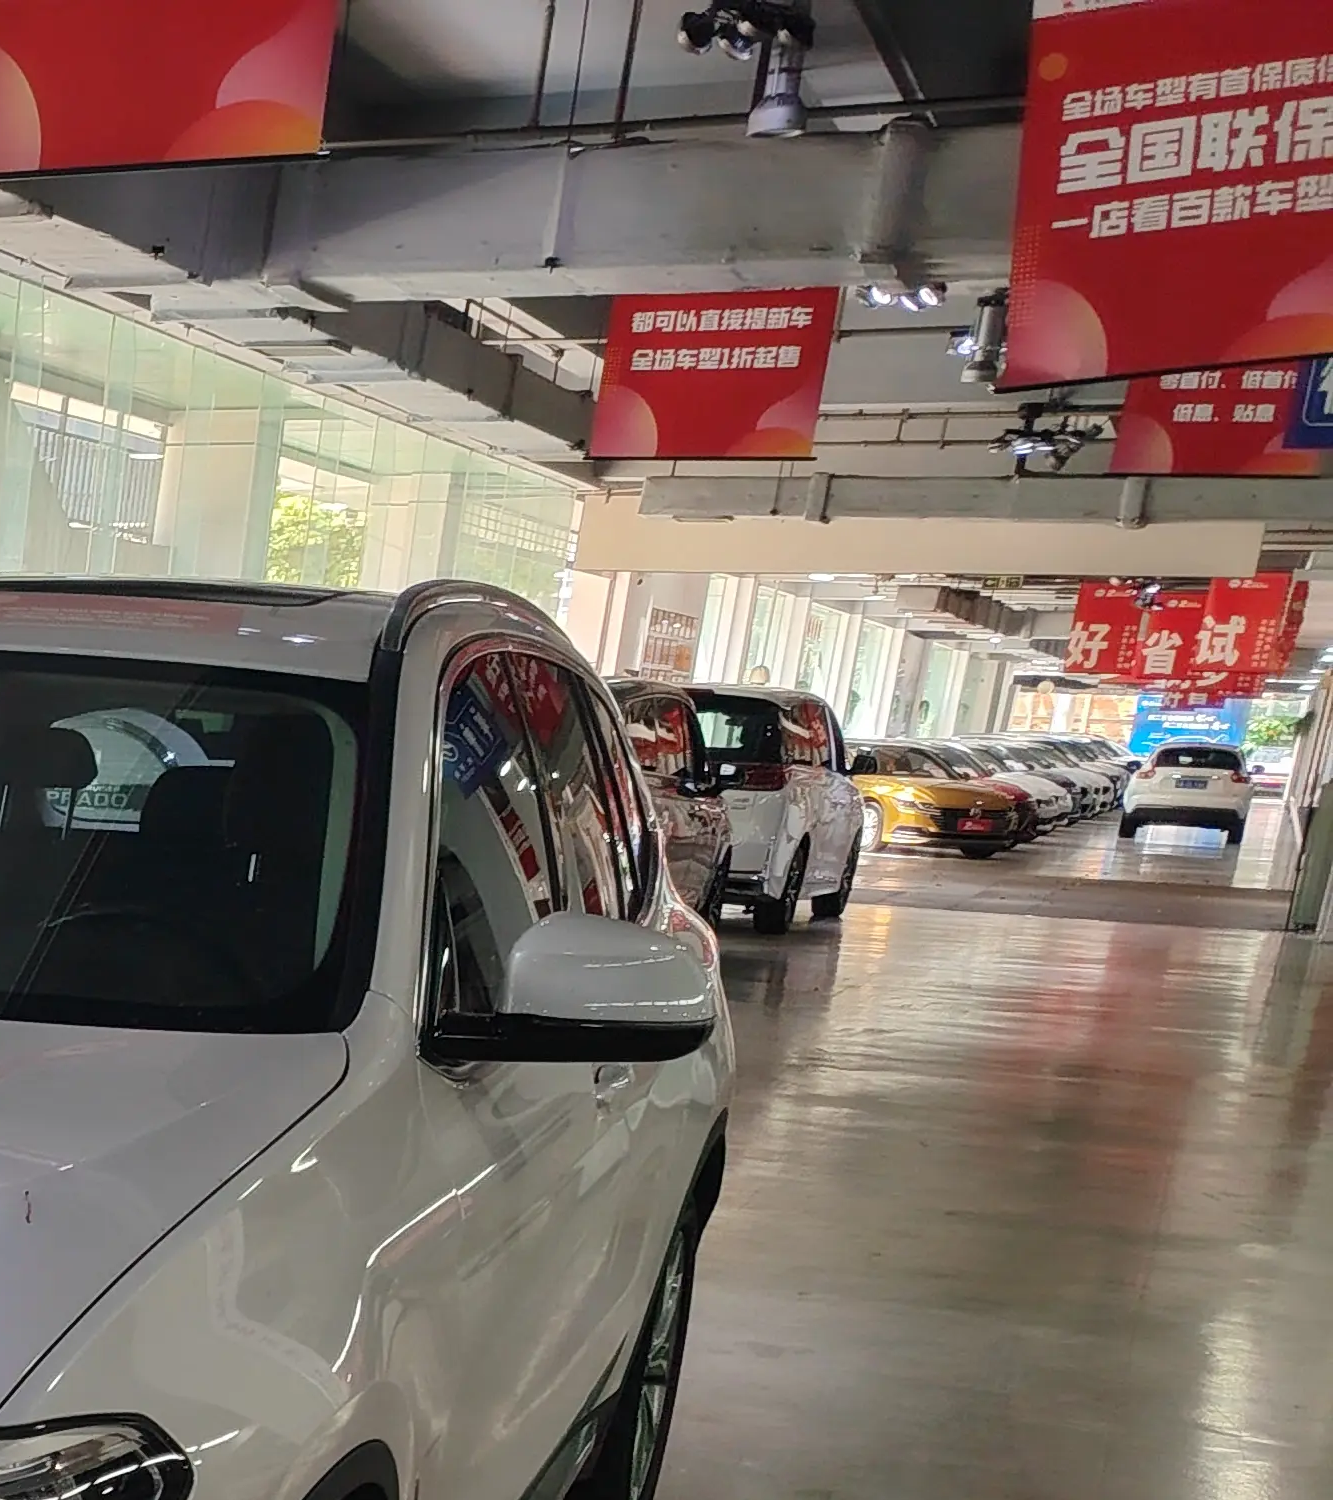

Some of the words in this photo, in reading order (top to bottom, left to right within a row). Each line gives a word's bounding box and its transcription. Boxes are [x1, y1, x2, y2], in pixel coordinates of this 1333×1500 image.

[1056, 96, 1333, 194] 全国联保
[1051, 174, 1333, 240] 一店看百款车型
[631, 306, 814, 333] 都可以直接提新车
[630, 345, 802, 371] 全场车型1折起售
[1065, 621, 1111, 669] 好
[1141, 629, 1183, 675] 省
[1194, 614, 1246, 666] 试
